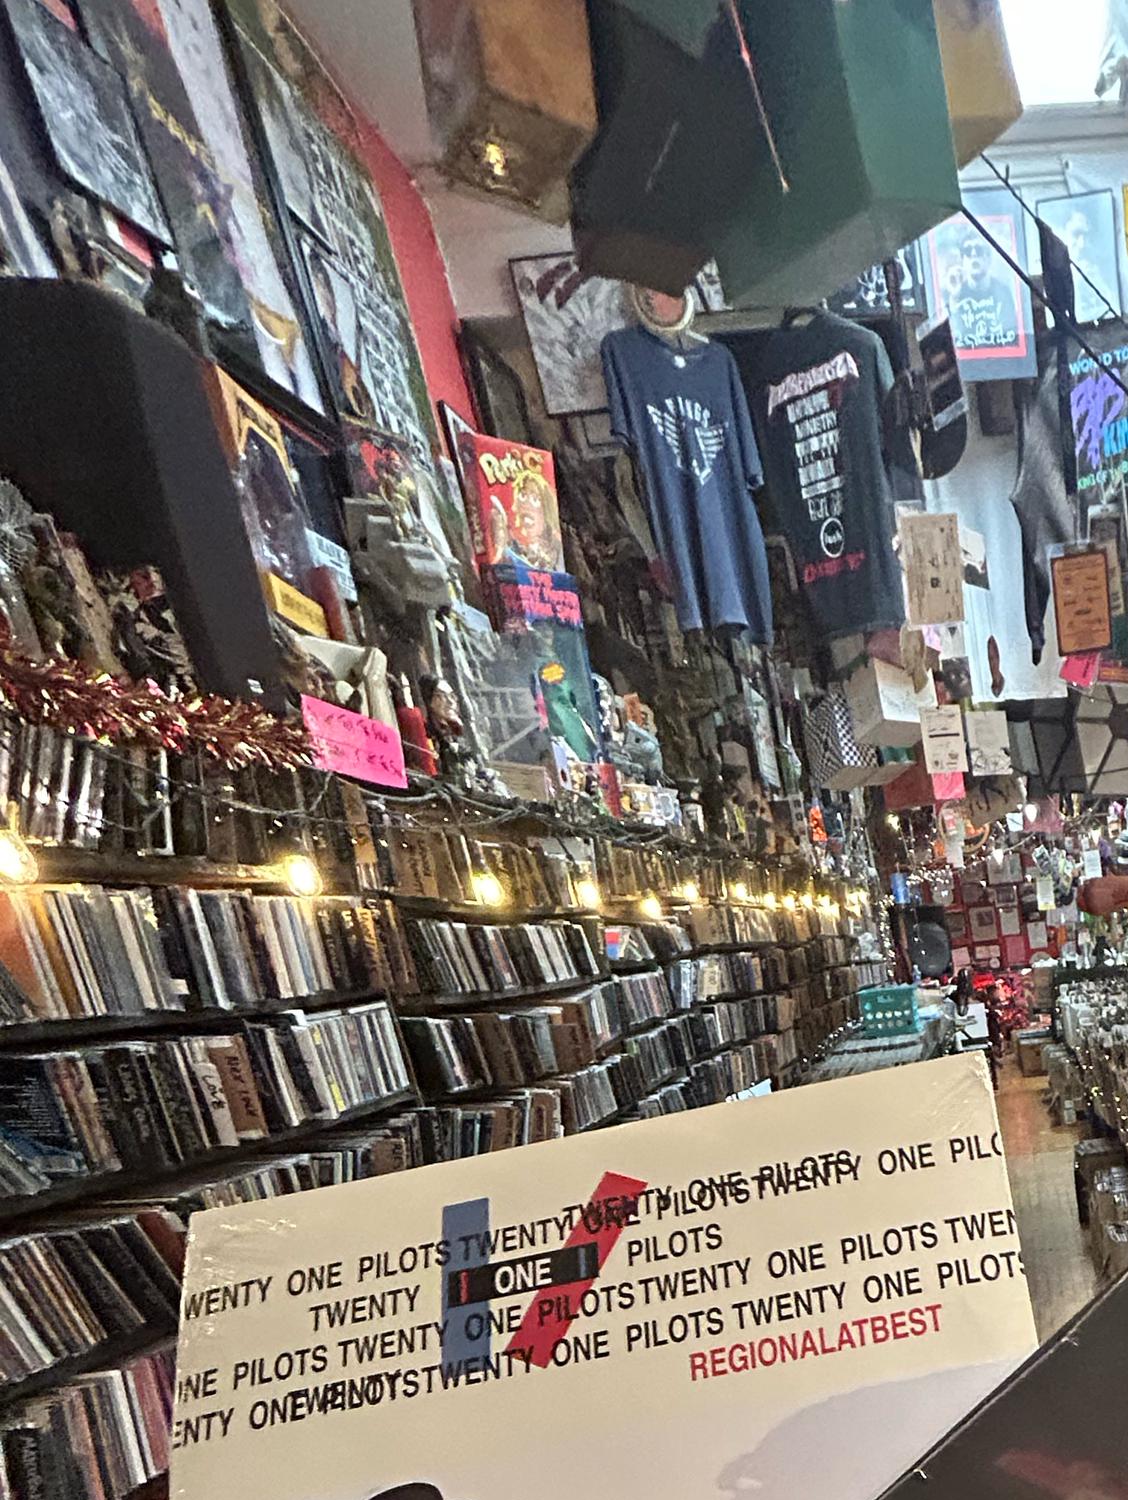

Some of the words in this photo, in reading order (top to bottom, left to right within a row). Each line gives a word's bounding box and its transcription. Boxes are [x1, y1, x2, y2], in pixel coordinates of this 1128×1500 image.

[1069, 353, 1112, 376] WORD
[287, 1262, 343, 1297] ONE
[358, 1240, 451, 1283] PILOTS
[878, 1143, 936, 1176] ONE
[308, 1285, 421, 1332] TWENTY
[494, 1258, 553, 1294] ONE
[627, 1224, 723, 1266] PILOTS
[178, 1368, 218, 1403] NE
[233, 1345, 328, 1389] PILOTS
[338, 1321, 450, 1368] TWENTY
[464, 1304, 522, 1341] ONE
[538, 1282, 635, 1326] PILOTS
[639, 1257, 751, 1304] TWENTY
[767, 1243, 827, 1279] ONE
[840, 1222, 938, 1264] PILOTS
[249, 1390, 306, 1431] ONE
[422, 1344, 534, 1394] TWENTY
[552, 1330, 610, 1366] ONE
[627, 1307, 724, 1352] PILOTS
[732, 1282, 846, 1330] TWENTY
[863, 1267, 922, 1303] ONE
[689, 1303, 943, 1382] REGIONALATBEST
